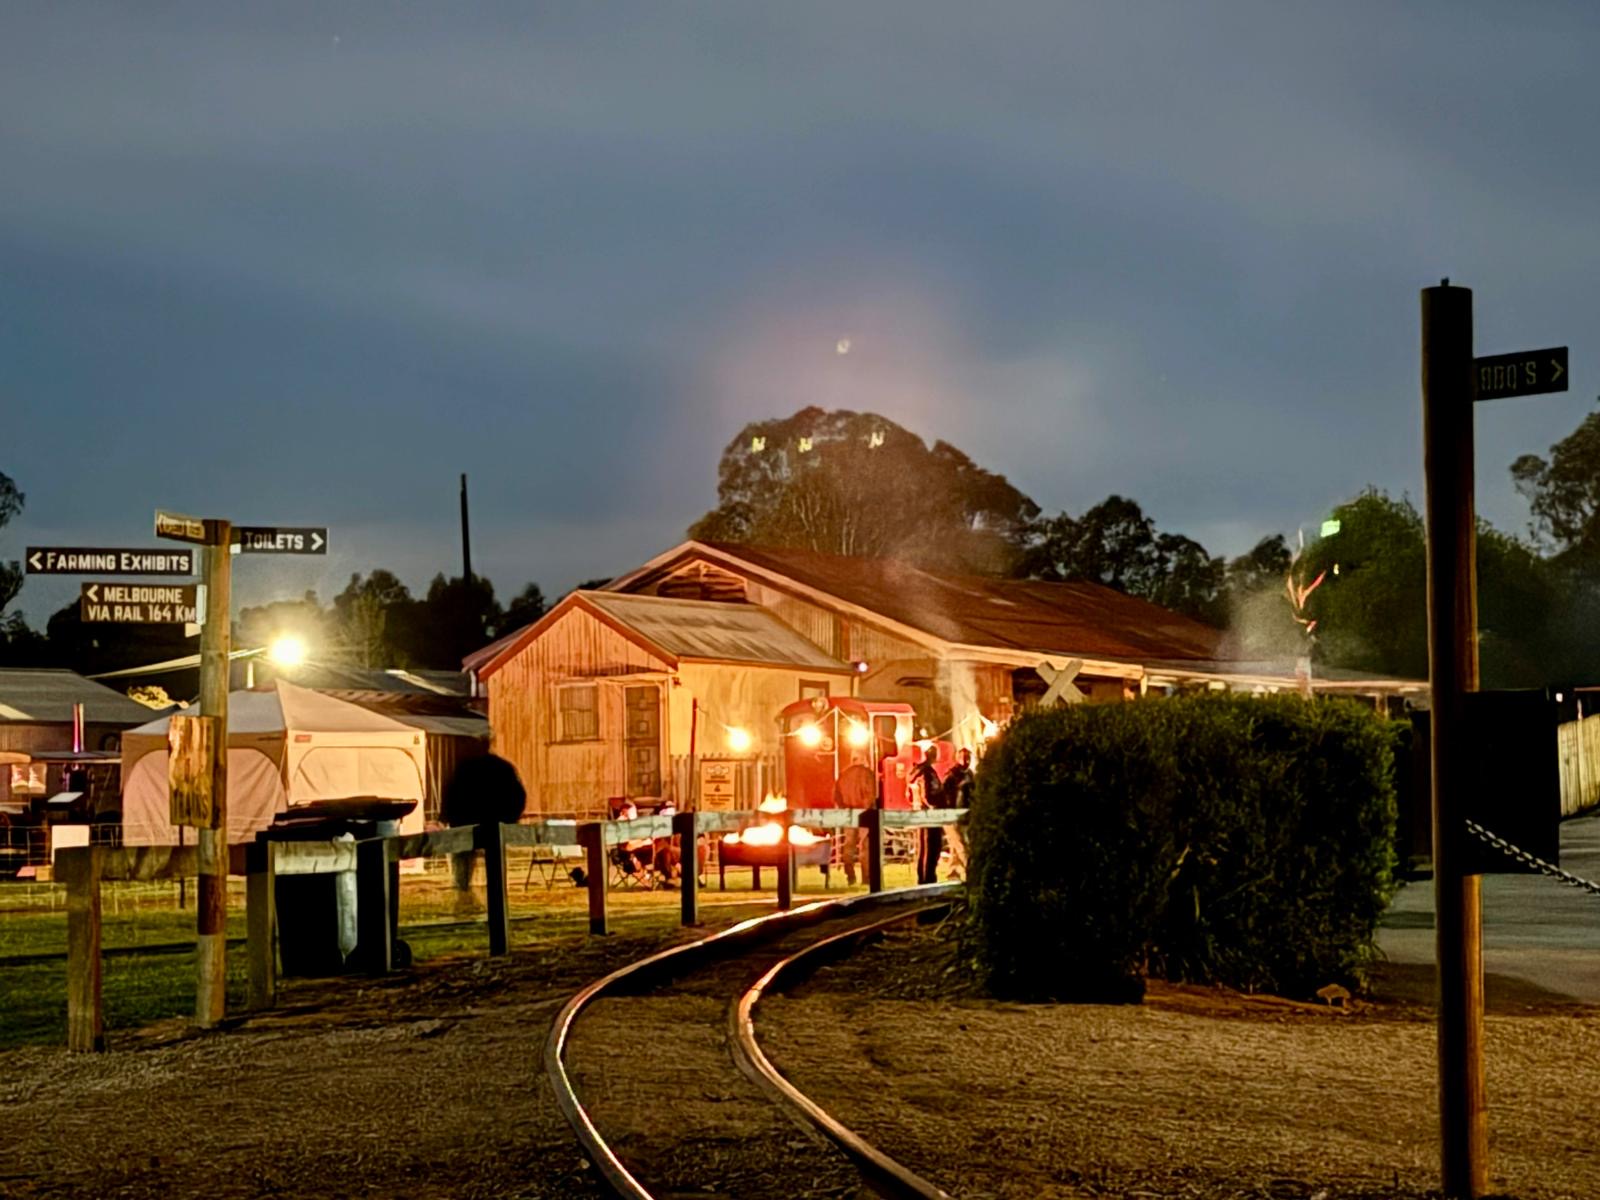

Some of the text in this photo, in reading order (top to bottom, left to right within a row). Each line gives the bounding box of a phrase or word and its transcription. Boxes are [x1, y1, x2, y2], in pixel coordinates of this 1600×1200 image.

[245, 532, 304, 550] TOILETS
[47, 552, 189, 571] FARMING EXHIBITS
[104, 586, 183, 603] MELBOURNE
[88, 605, 110, 621] VIA
[114, 605, 144, 621] RAIL
[148, 605, 171, 621] 164
